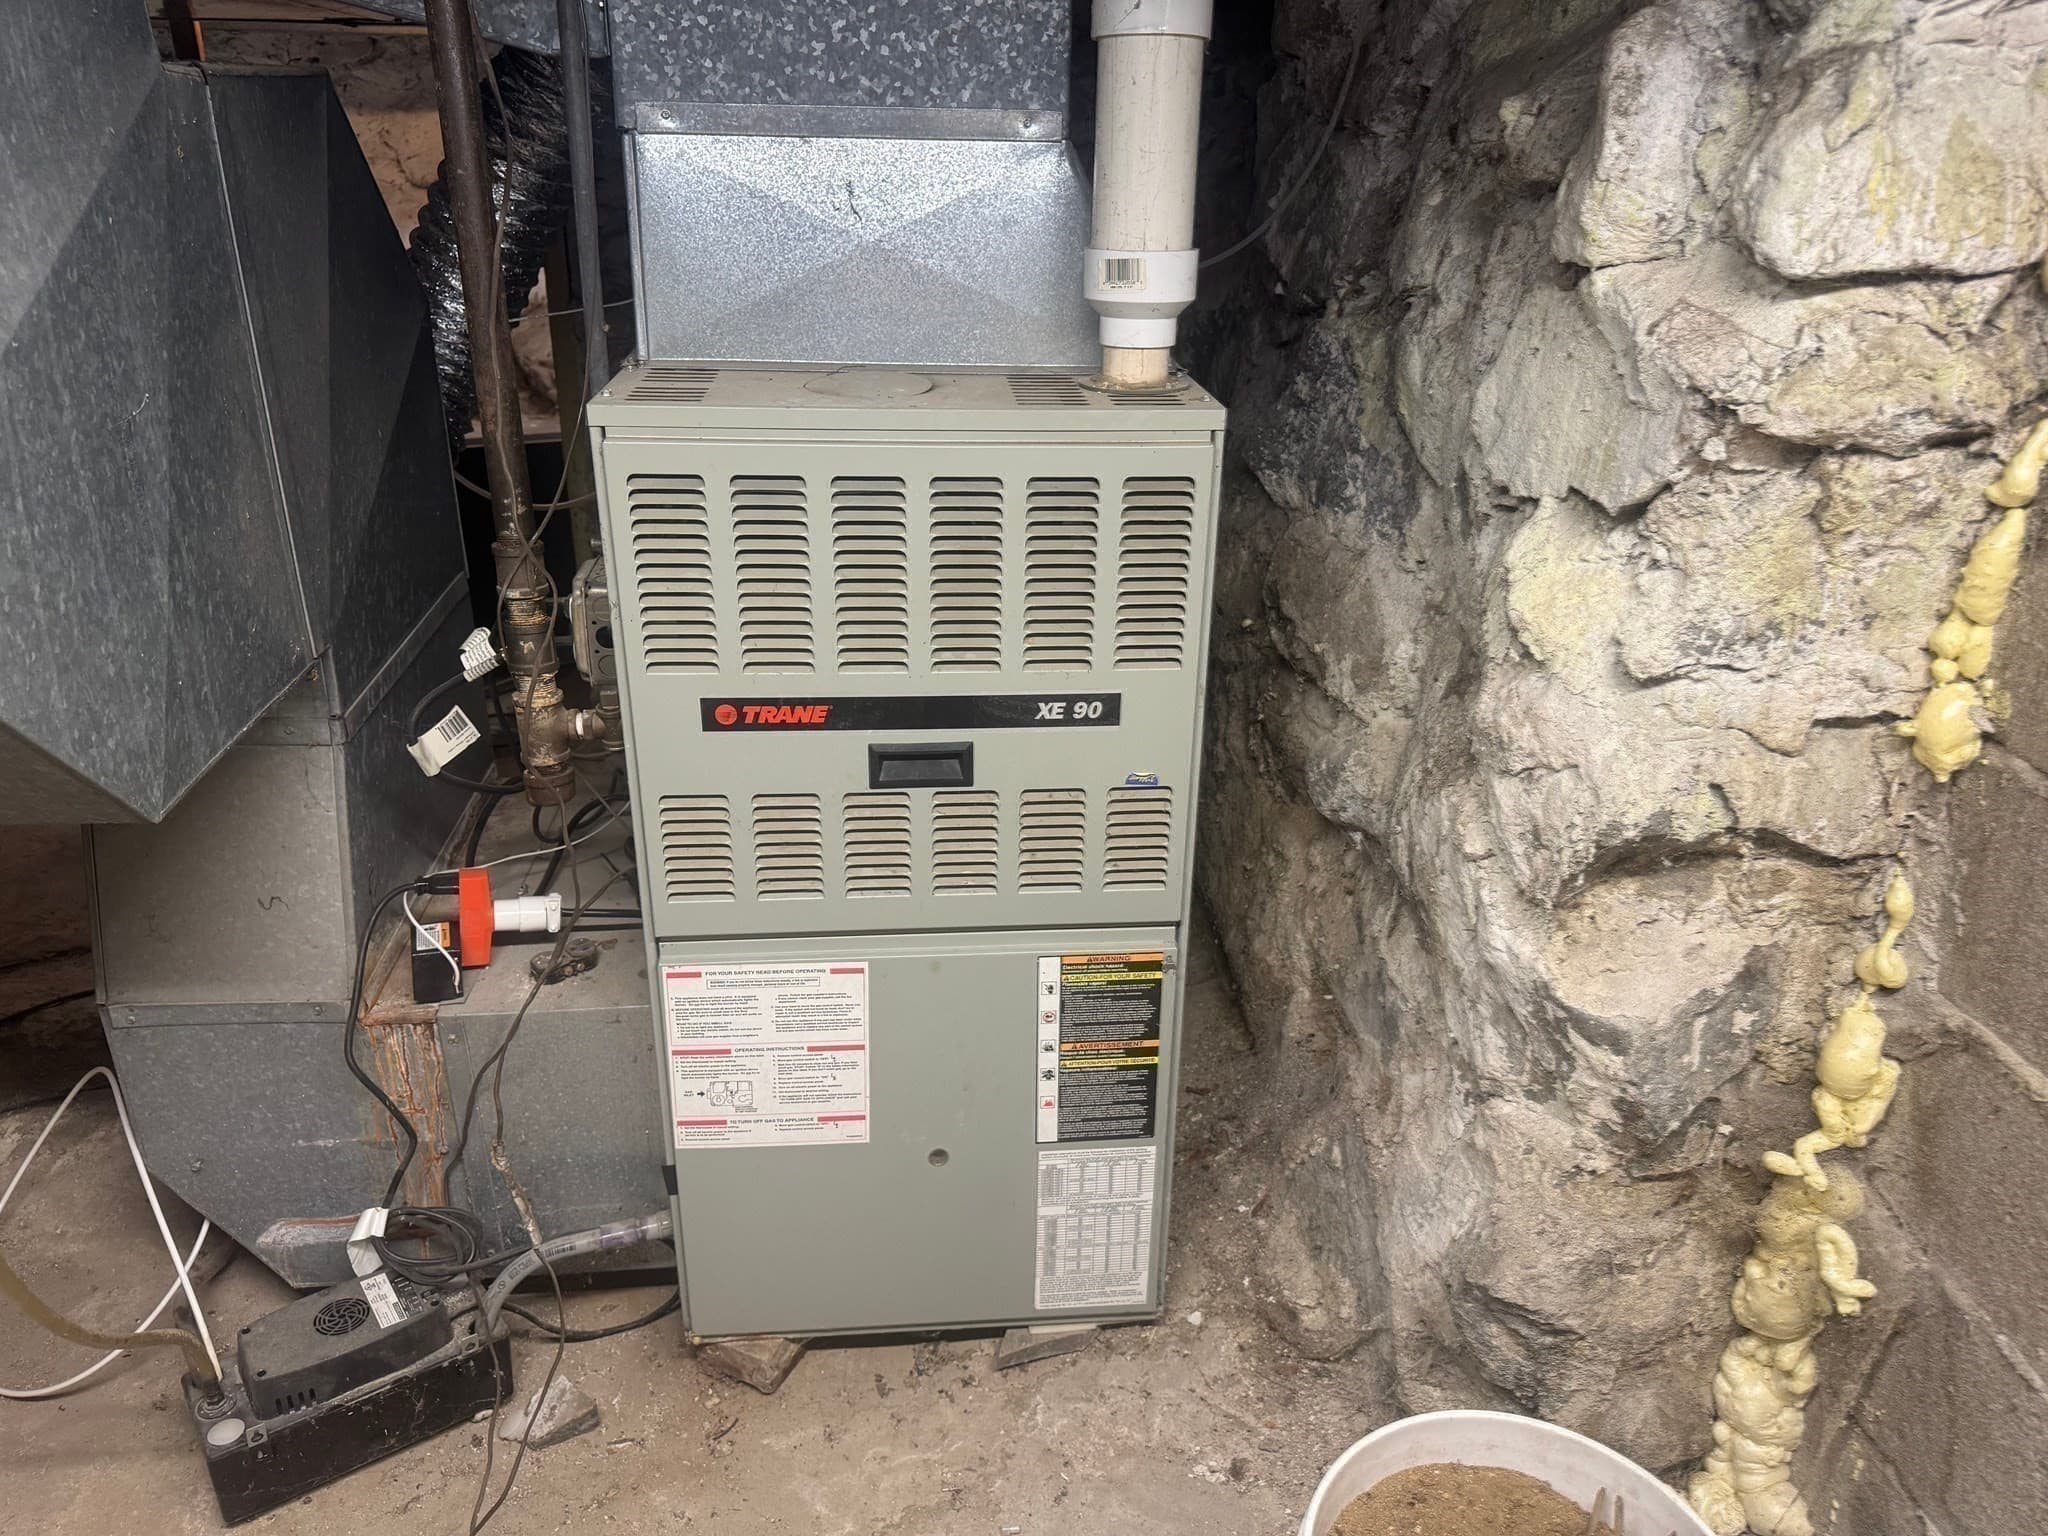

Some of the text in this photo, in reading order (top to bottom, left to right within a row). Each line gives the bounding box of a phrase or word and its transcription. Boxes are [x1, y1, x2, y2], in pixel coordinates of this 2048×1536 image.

[743, 705, 829, 724] TRANE
[1034, 701, 1103, 720] XE 90
[1079, 1041, 1143, 1049] AVERTISSEMENT
